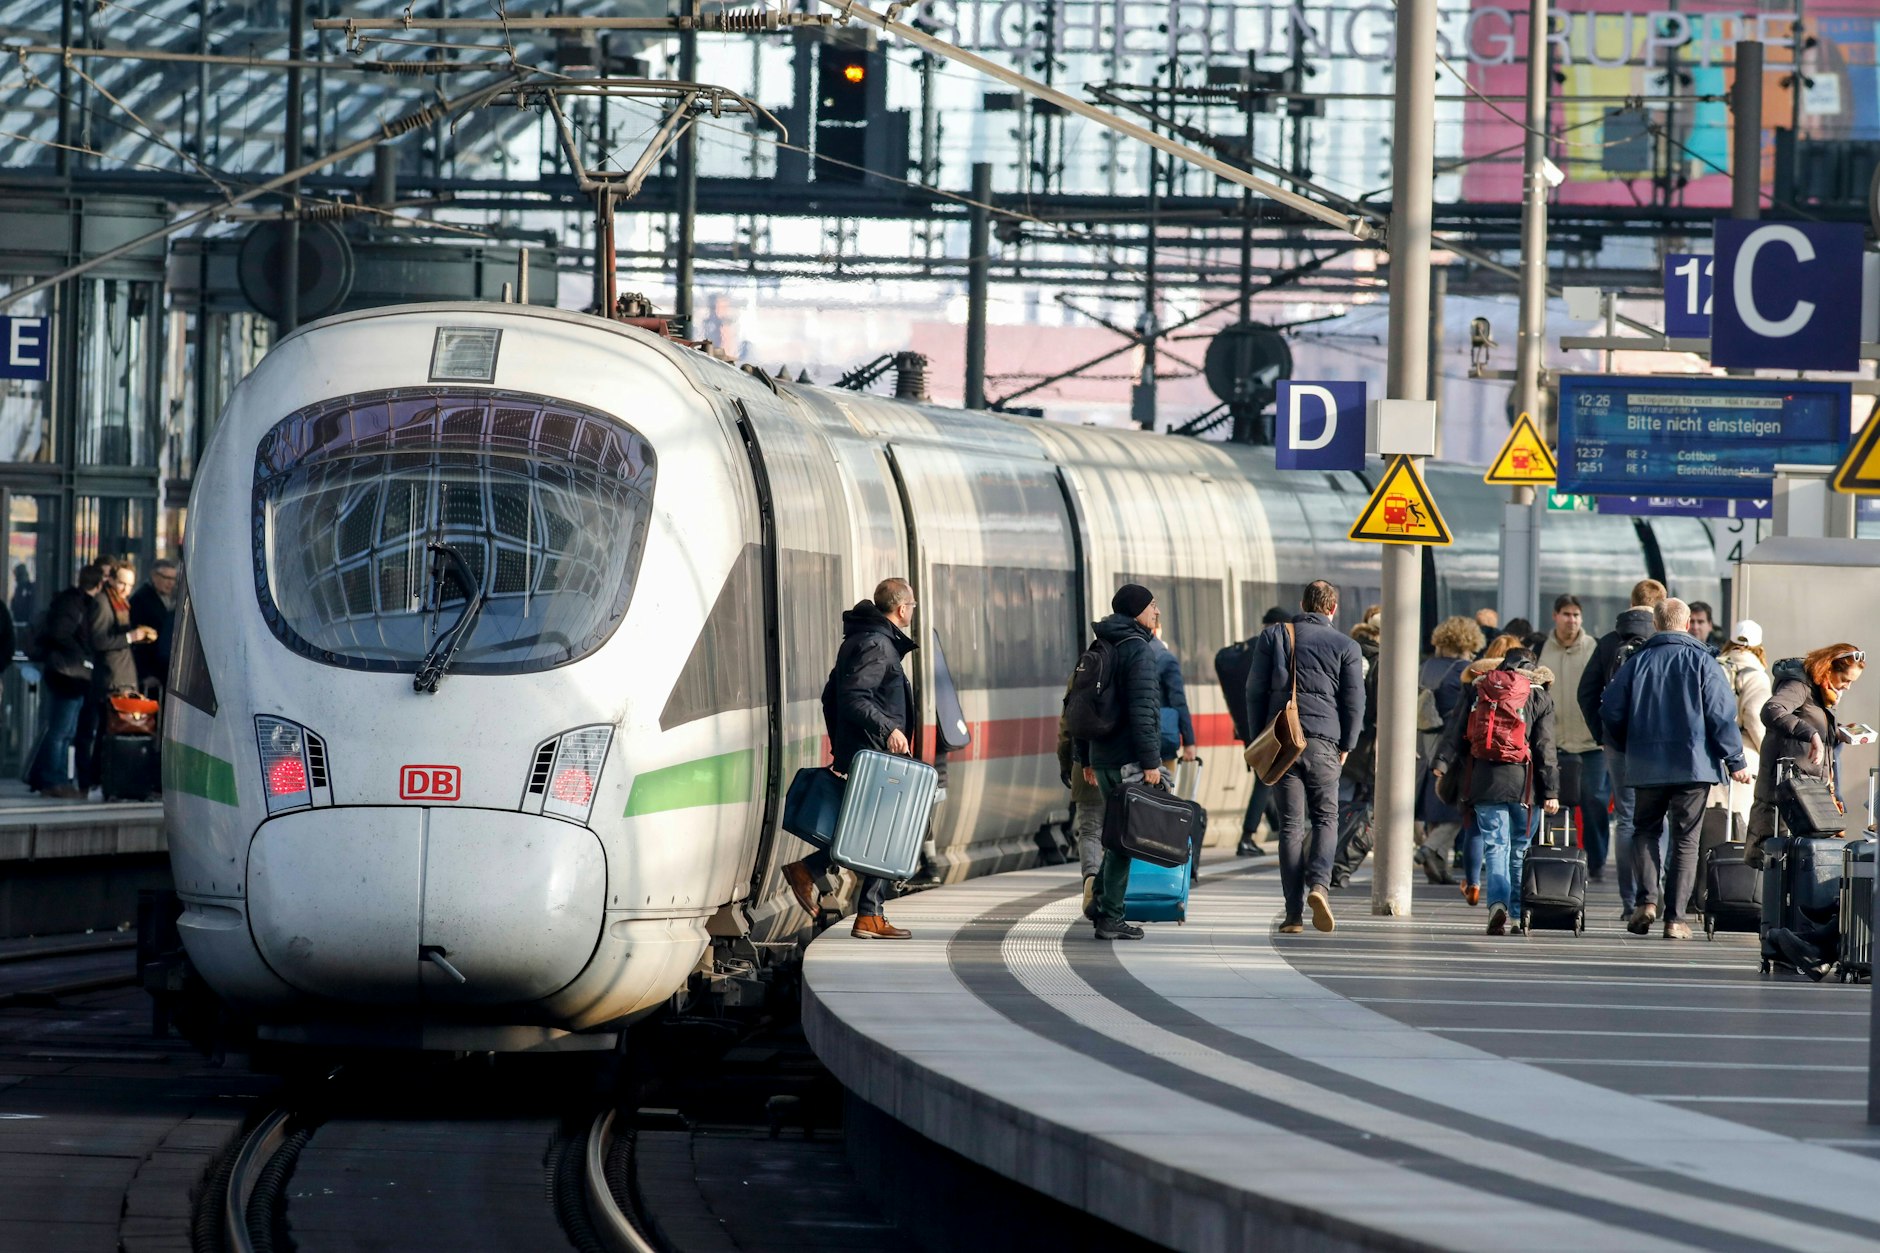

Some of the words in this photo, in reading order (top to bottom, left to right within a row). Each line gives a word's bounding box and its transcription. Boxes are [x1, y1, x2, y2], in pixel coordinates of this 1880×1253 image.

[1733, 224, 1816, 338] C
[9, 318, 41, 366] E
[1578, 394, 1611, 407] 12:26
[1289, 385, 1338, 449] D
[1627, 415, 1661, 430] Bitte
[1666, 416, 1702, 431] nicht
[1708, 418, 1781, 437] einsteigen
[1576, 448, 1604, 458] 12:37
[1626, 450, 1638, 459] RE
[1641, 450, 1647, 459] 2
[1677, 450, 1717, 461] Cottbus
[1576, 462, 1603, 472] 12:51
[1626, 464, 1638, 473] RE
[1642, 464, 1647, 473] 1
[1727, 539, 1744, 562] 4
[408, 771, 454, 794] DB
